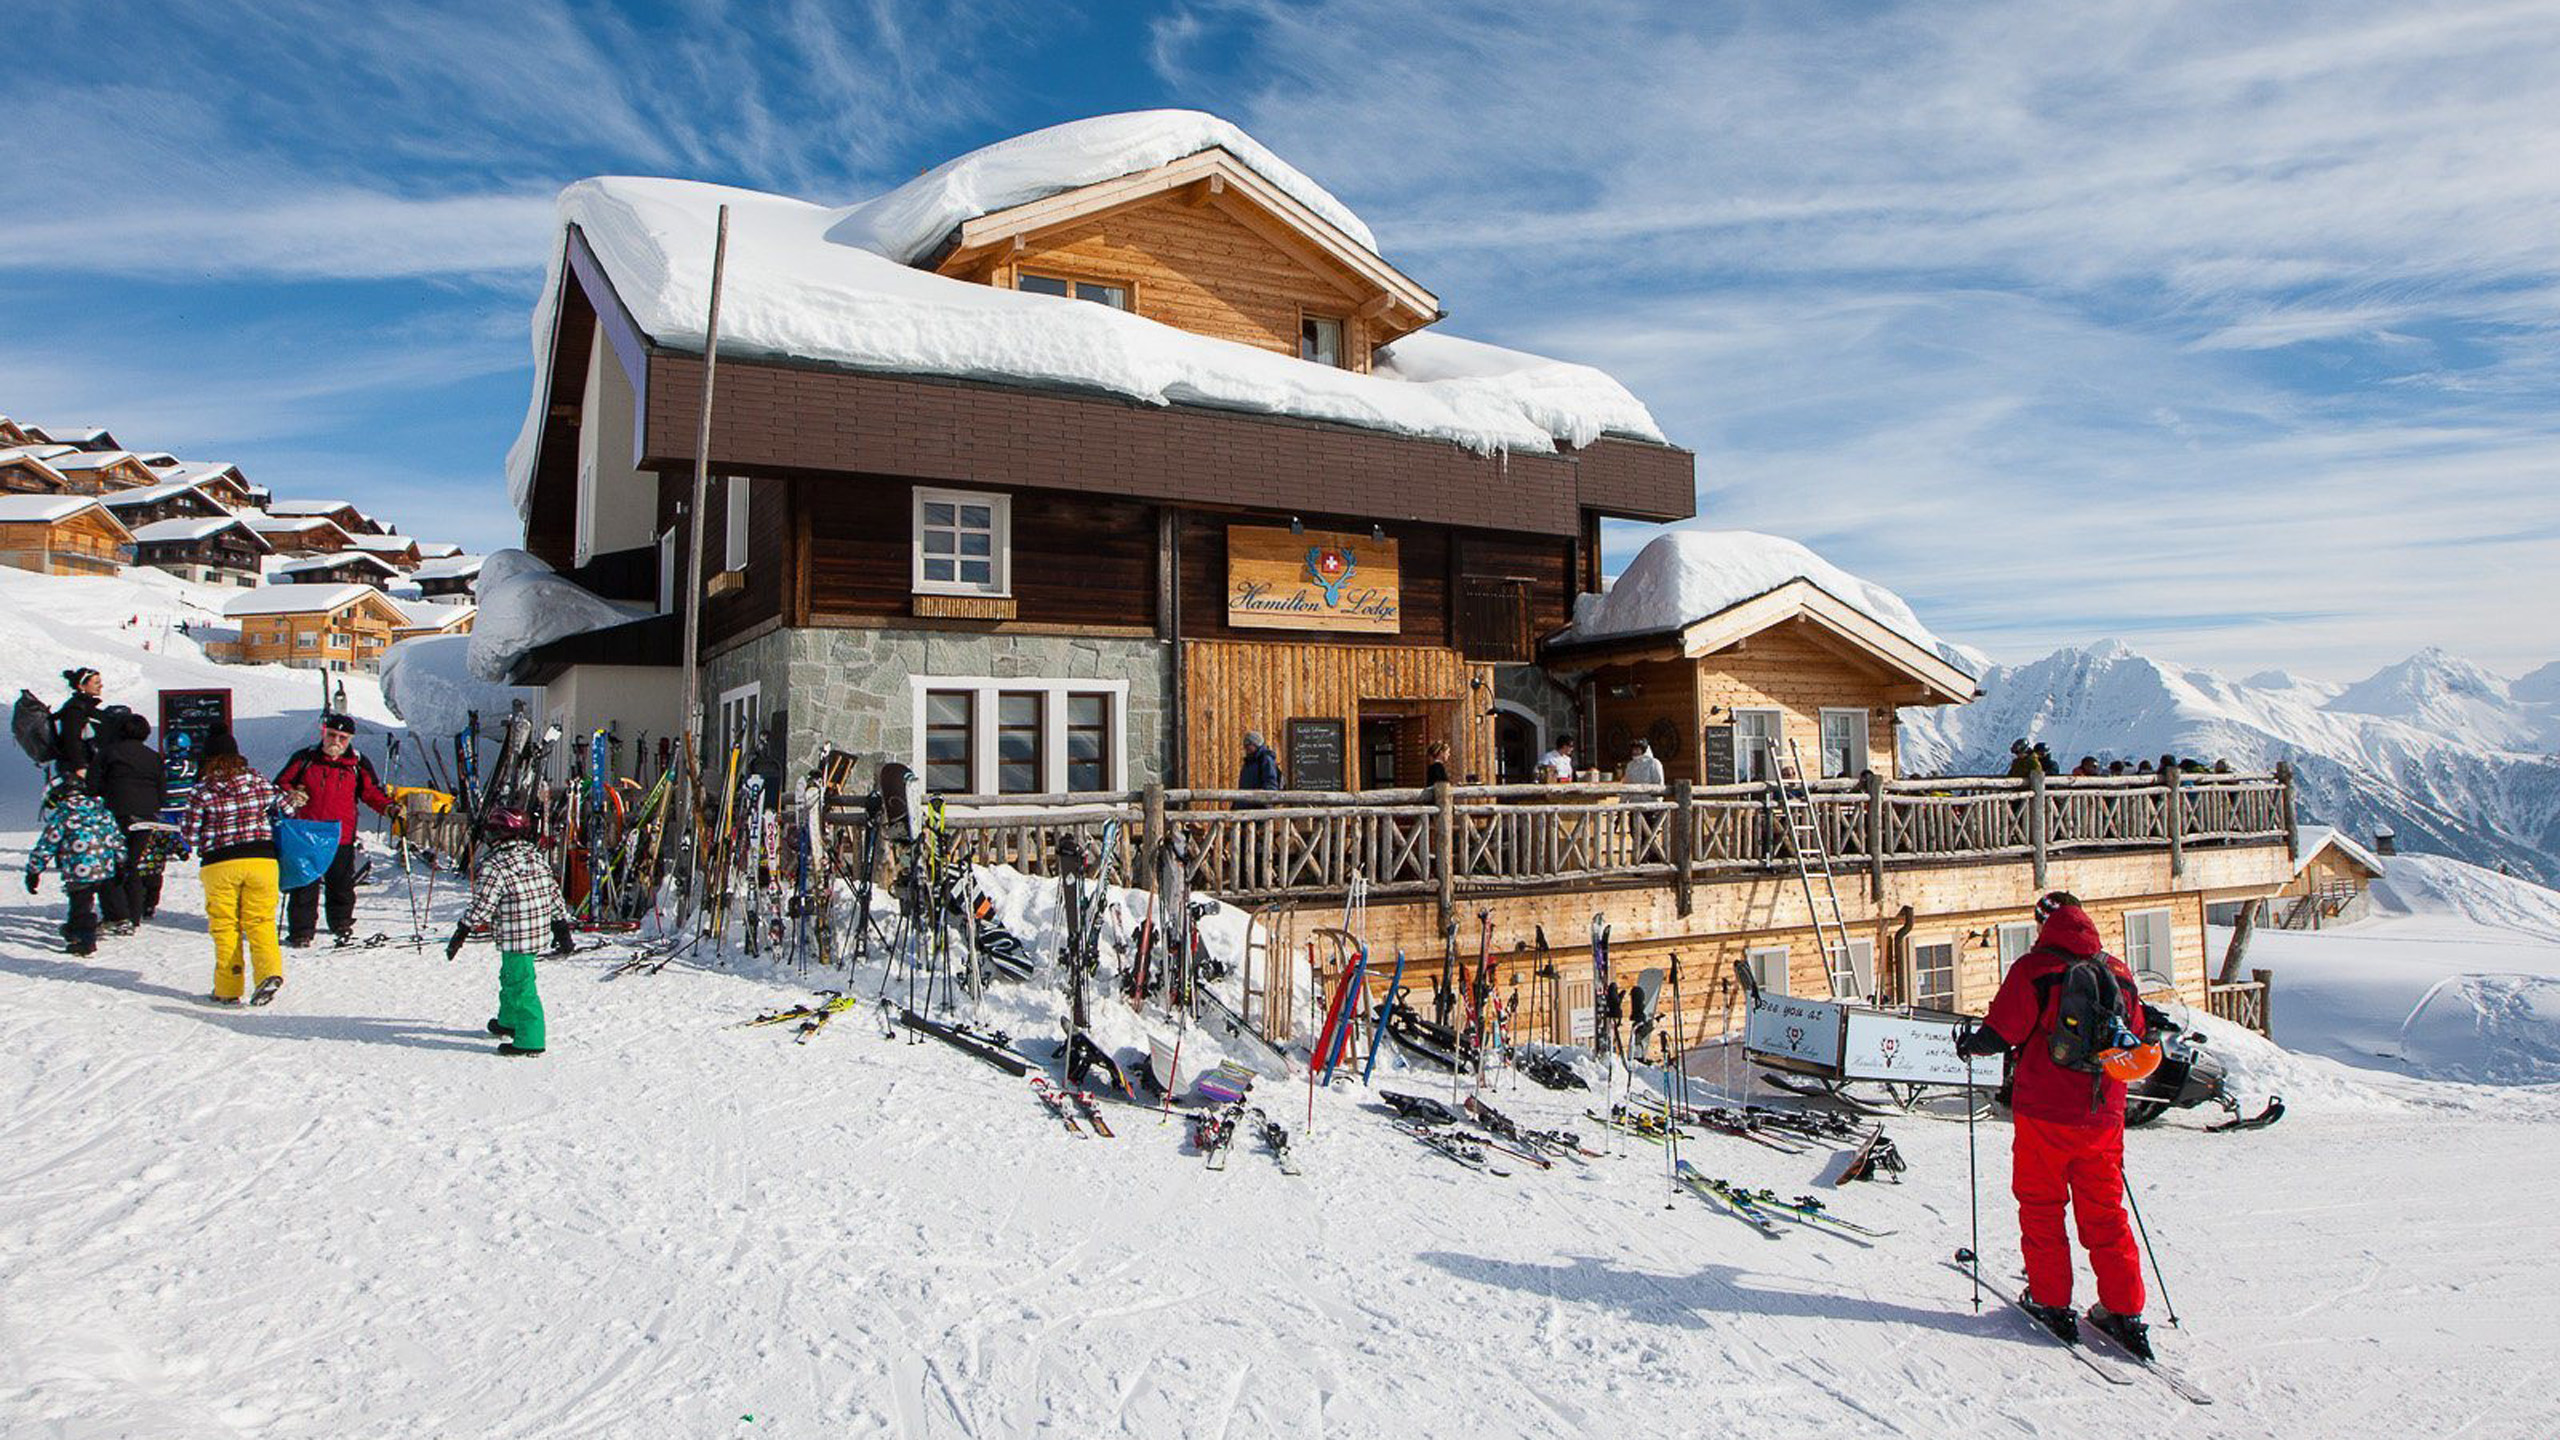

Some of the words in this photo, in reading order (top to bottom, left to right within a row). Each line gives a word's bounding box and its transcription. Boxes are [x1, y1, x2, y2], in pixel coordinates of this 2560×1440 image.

[1229, 580, 1321, 612] Hamilton
[1340, 588, 1397, 623] Lodge
[1761, 999, 1779, 1013] See
[1784, 1005, 1804, 1018] you
[1808, 1009, 1823, 1020] at
